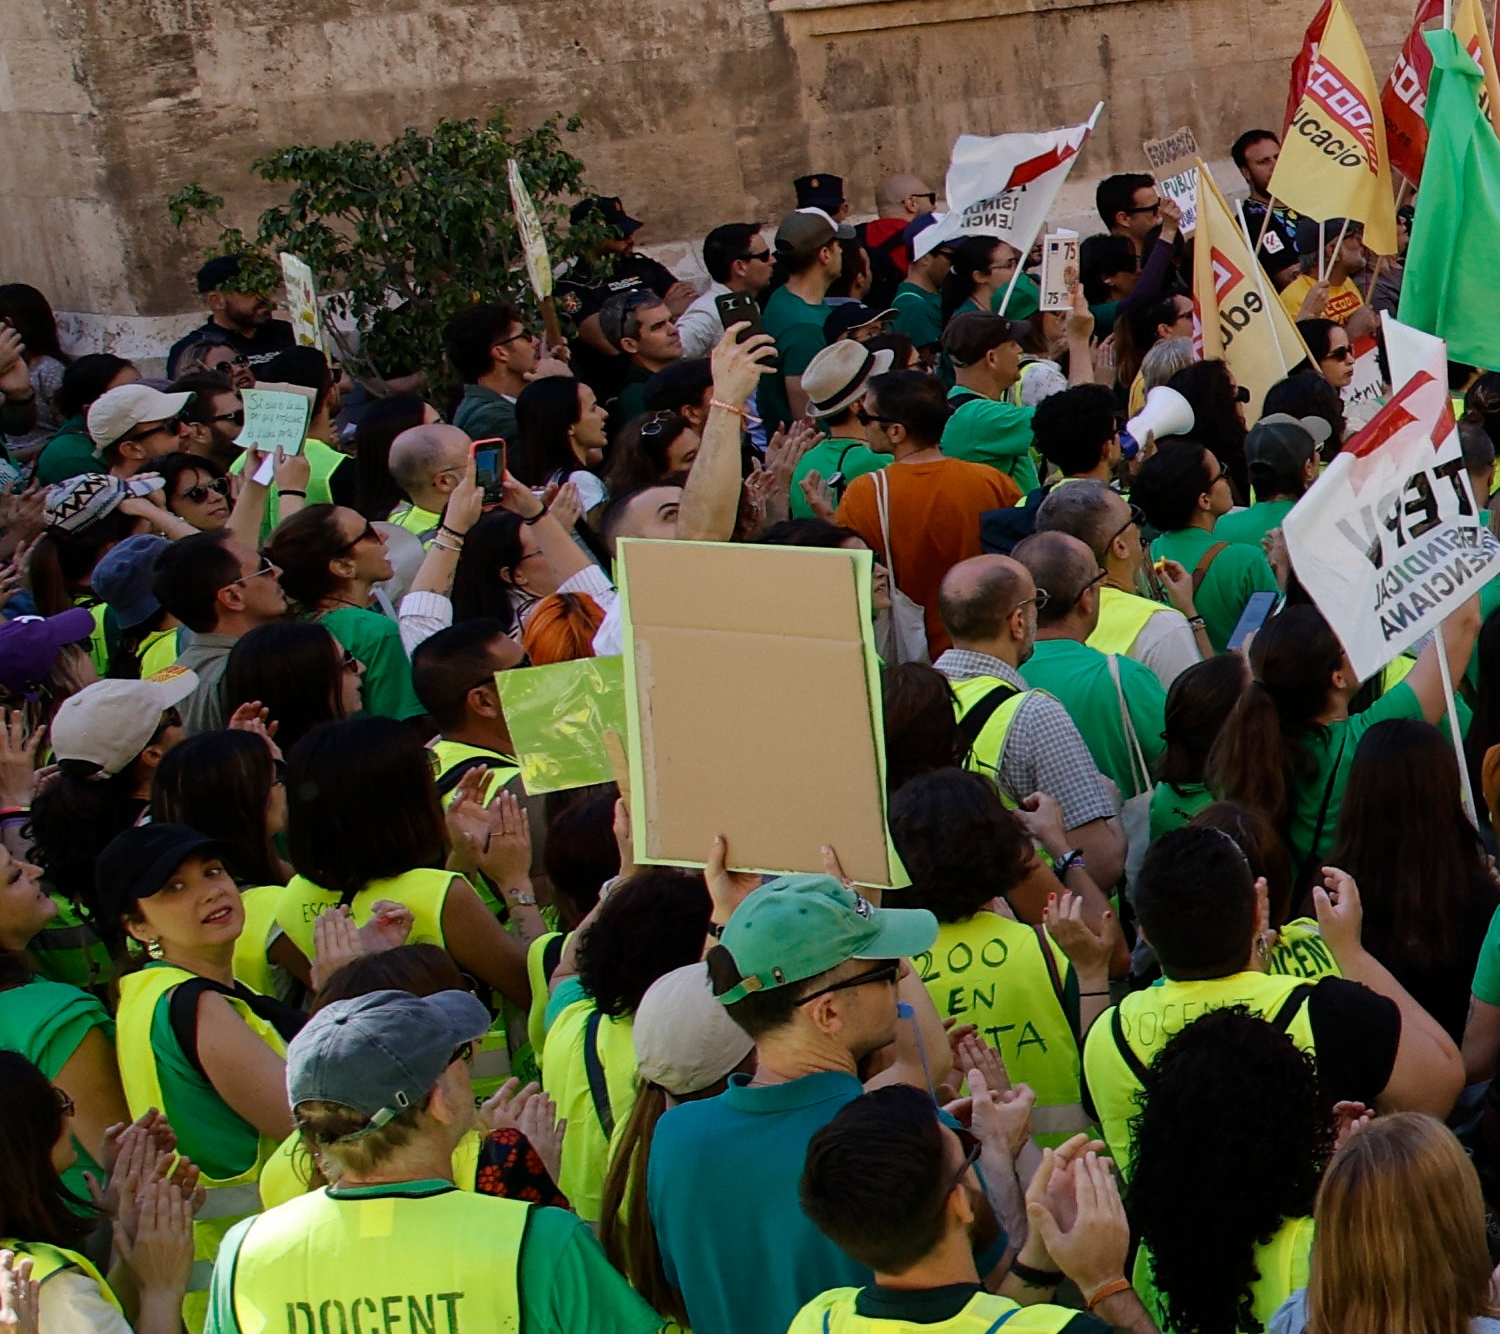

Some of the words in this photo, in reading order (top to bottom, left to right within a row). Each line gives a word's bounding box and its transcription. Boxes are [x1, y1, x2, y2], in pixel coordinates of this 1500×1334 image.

[1063, 241, 1076, 260] 75
[1048, 291, 1058, 305] 75
[947, 982, 996, 1016] EN
